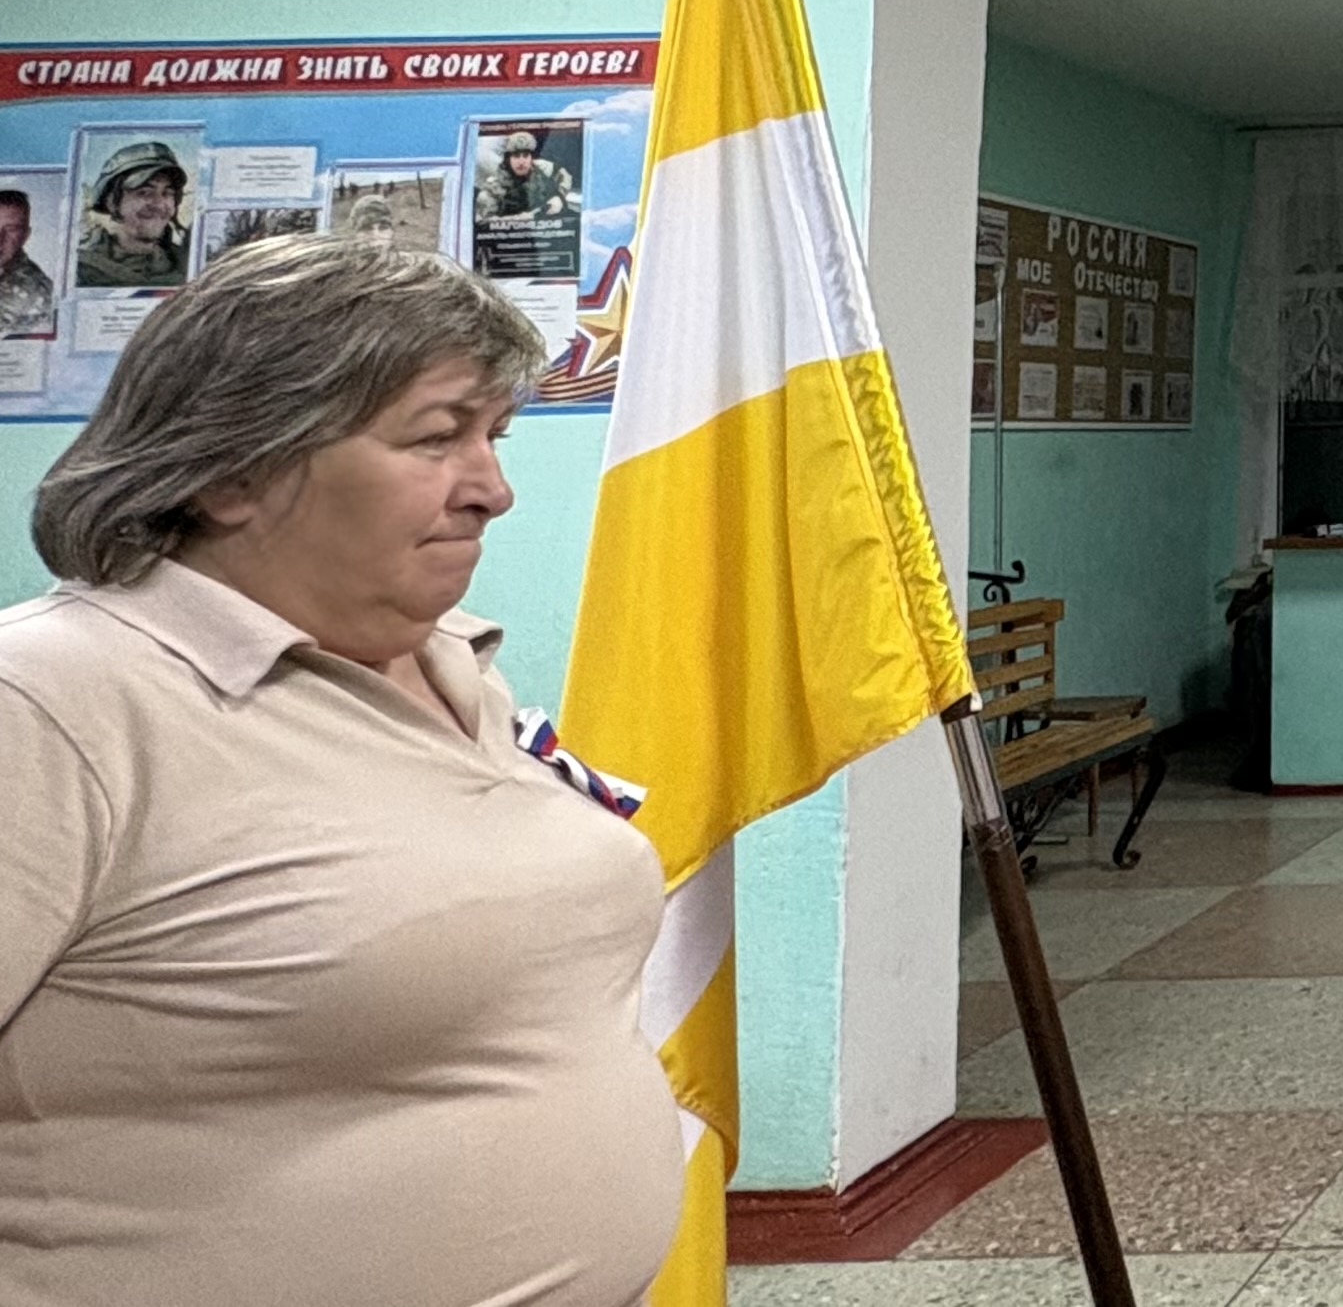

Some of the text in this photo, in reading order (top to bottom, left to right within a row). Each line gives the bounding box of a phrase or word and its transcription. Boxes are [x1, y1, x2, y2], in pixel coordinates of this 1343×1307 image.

[18, 49, 640, 87] СТРАНА ДОЛЖНА ЗНАТЬ СВОИХ ГЕРОЕВ!
[1047, 215, 1149, 269] РОССИЯ
[1016, 256, 1053, 285] МОЕ
